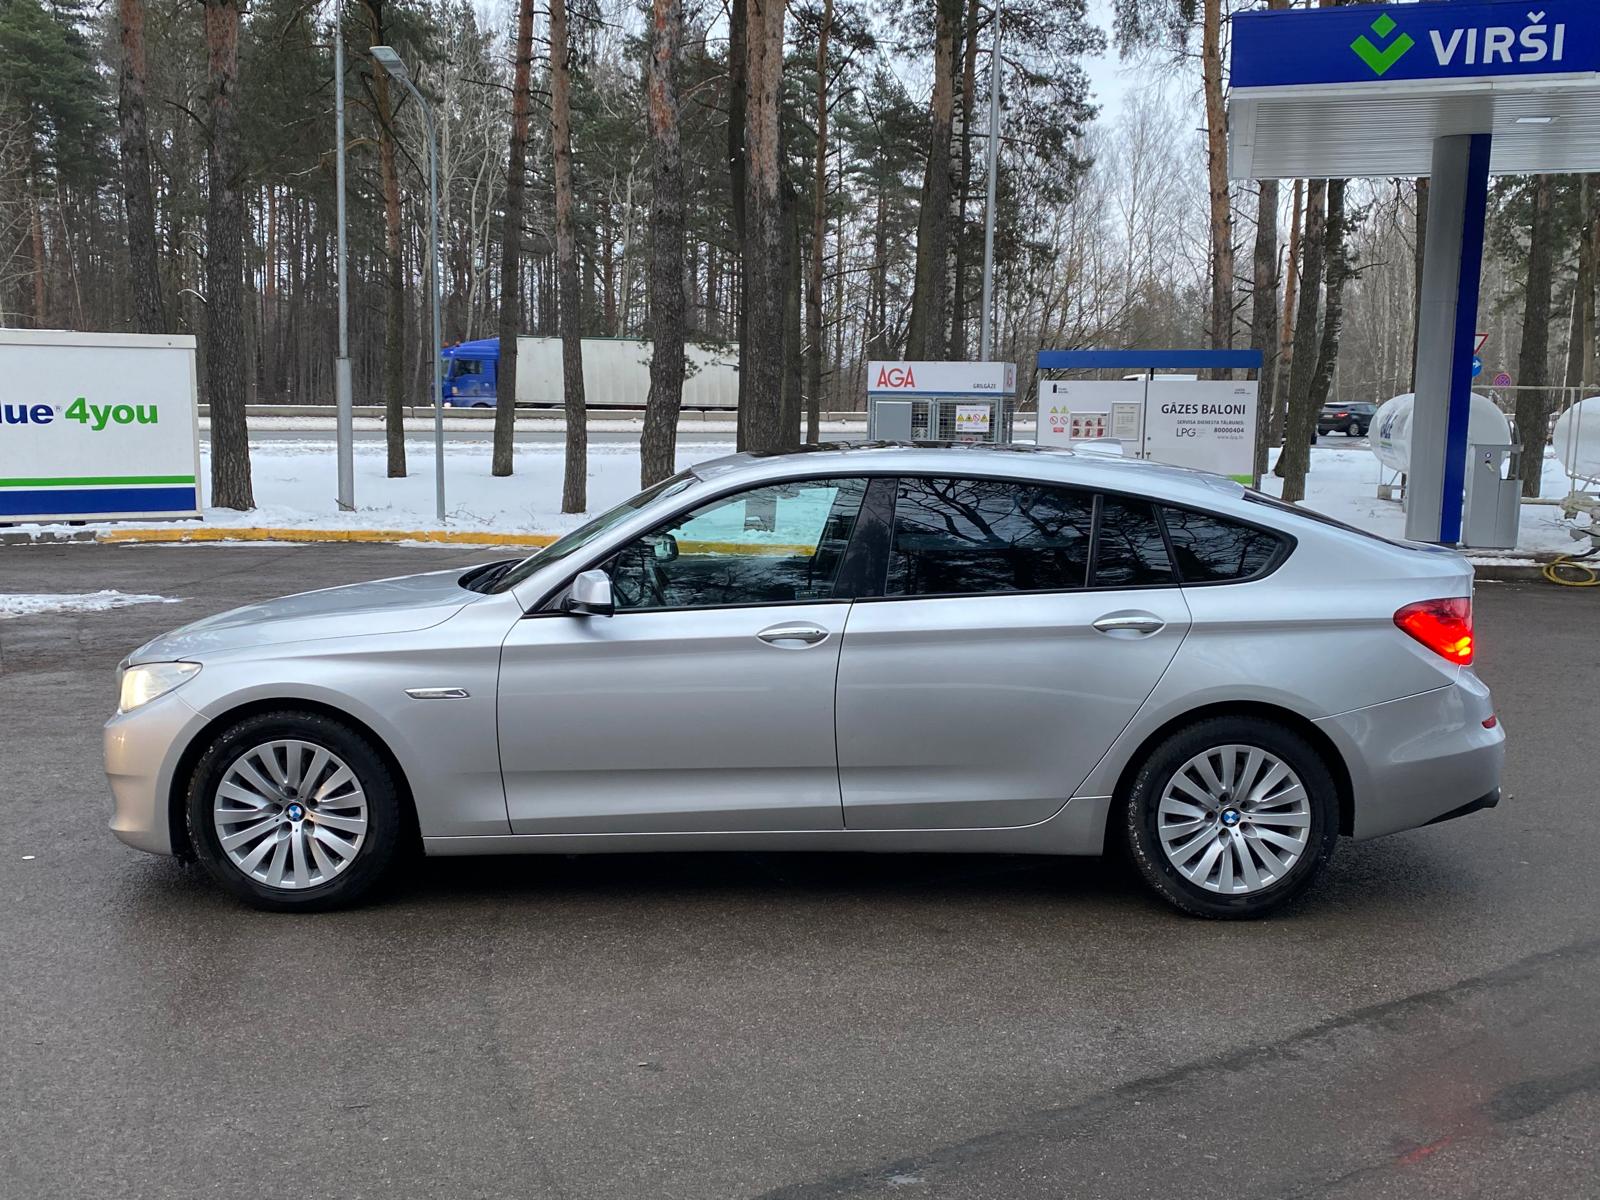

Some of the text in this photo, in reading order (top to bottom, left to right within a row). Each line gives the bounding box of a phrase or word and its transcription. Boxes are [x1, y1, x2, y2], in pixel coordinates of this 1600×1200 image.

[1429, 10, 1566, 66] VIRŠI
[876, 365, 916, 388] AGA
[64, 397, 158, 431] 4you
[1161, 402, 1246, 415] GĀZES BALONI
